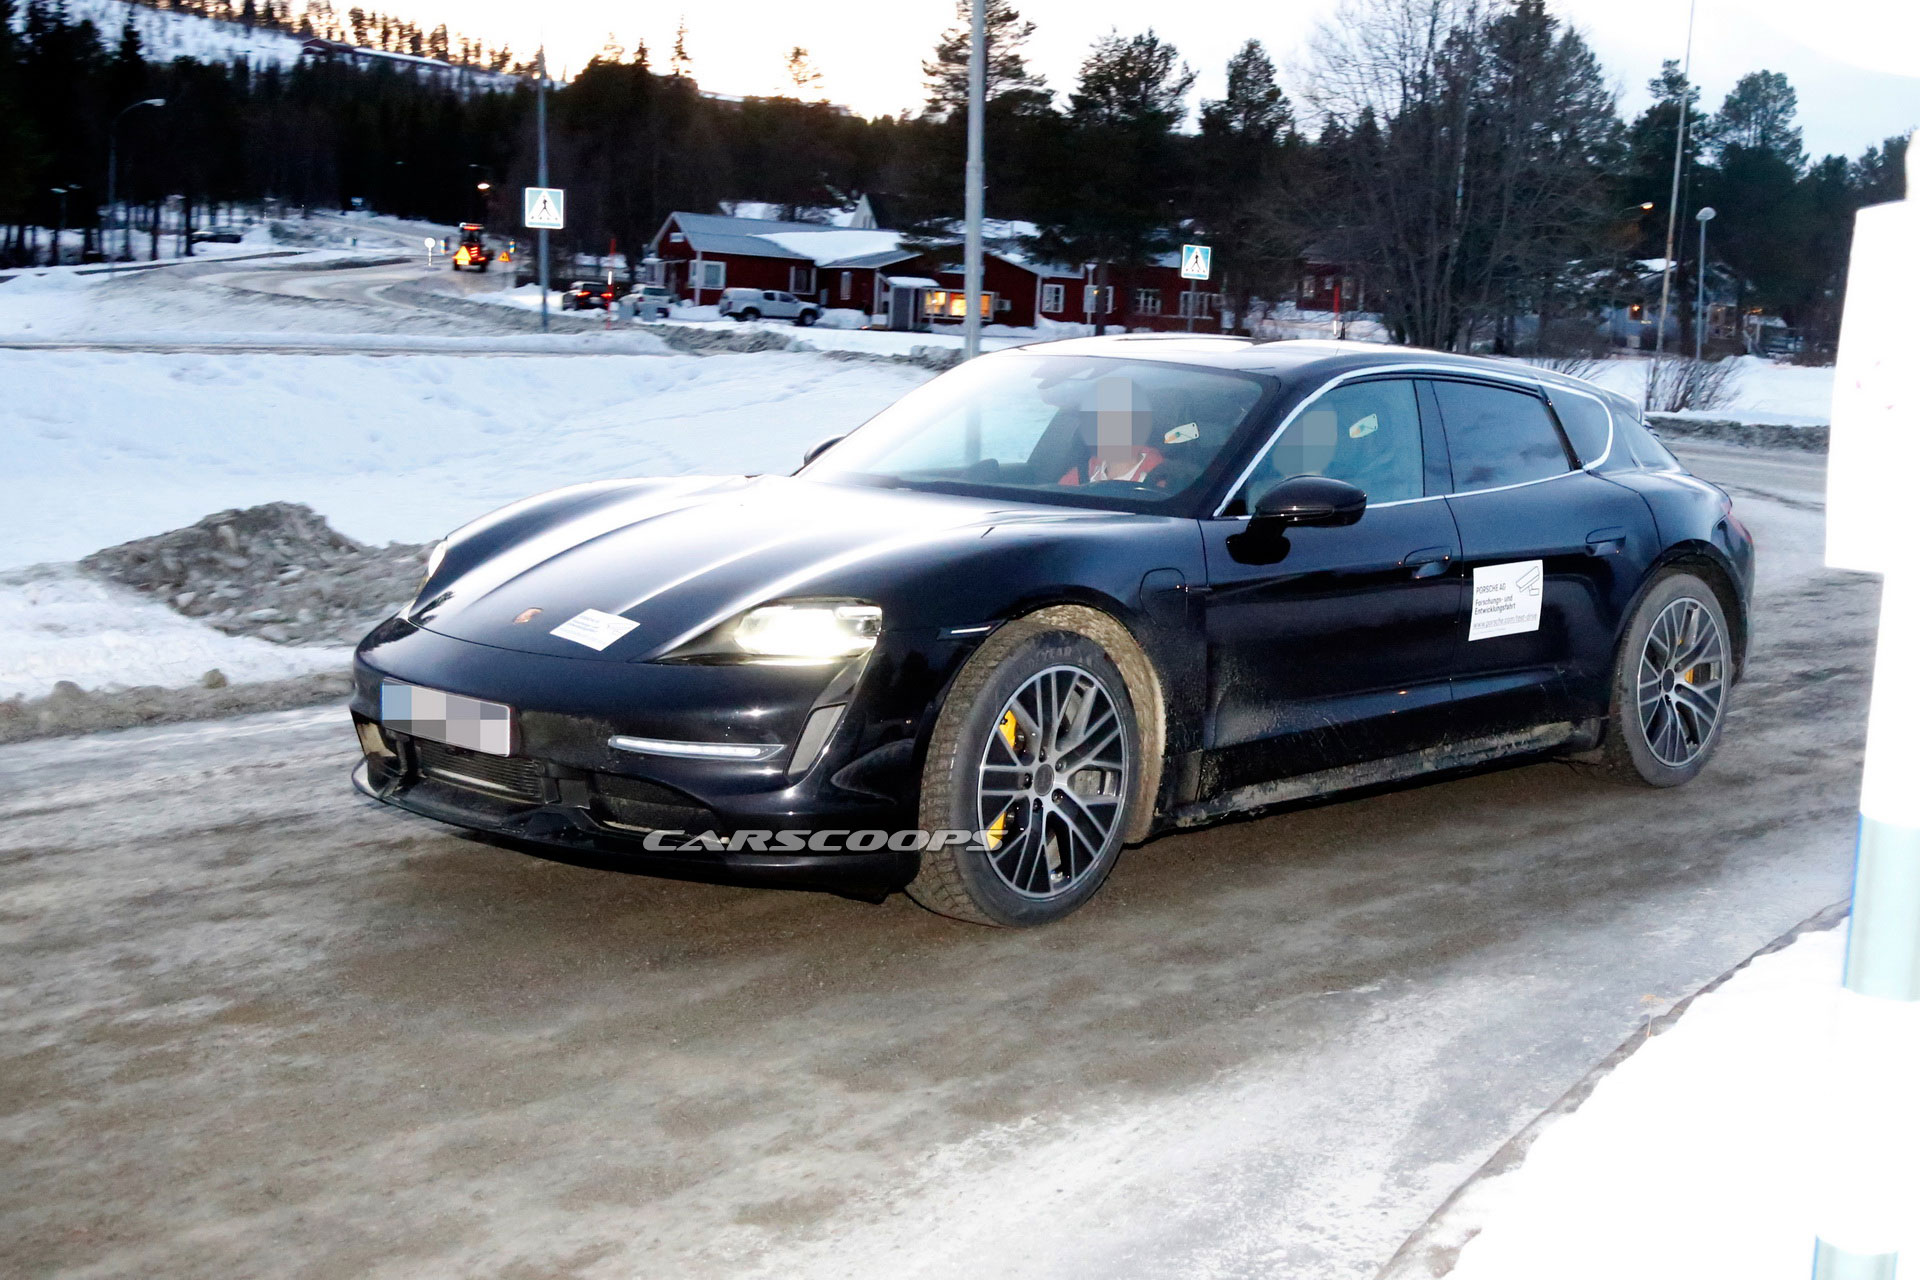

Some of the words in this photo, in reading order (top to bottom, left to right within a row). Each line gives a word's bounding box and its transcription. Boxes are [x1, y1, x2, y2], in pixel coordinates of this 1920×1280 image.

[1476, 584, 1499, 594] PORSCHE
[1499, 583, 1506, 591] AG
[1475, 597, 1504, 607] Forschungs-
[1504, 594, 1513, 602] und
[1475, 603, 1516, 615] Entwicklungsfahrt
